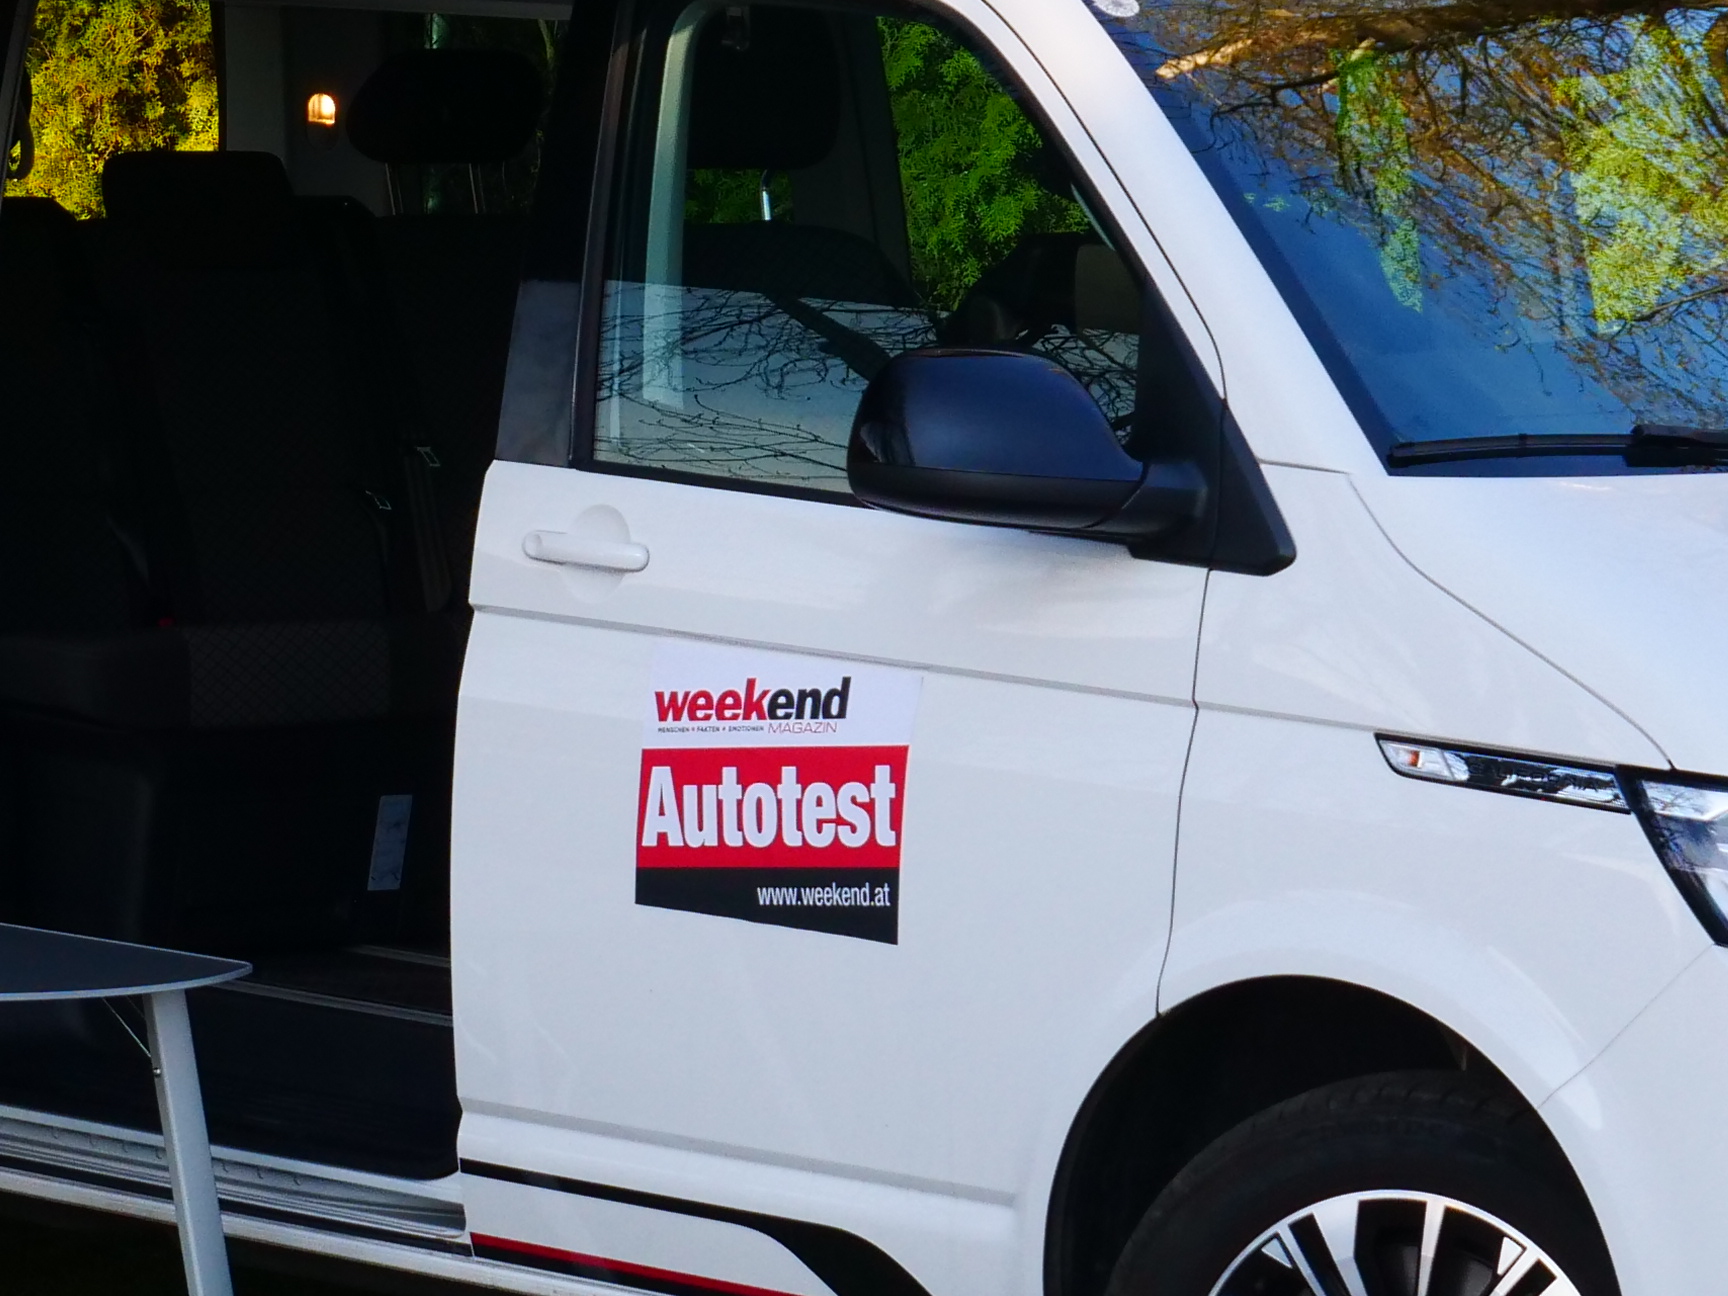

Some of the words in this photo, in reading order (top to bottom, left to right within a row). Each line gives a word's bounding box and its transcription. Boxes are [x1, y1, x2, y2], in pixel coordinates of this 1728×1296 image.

[654, 676, 852, 722] weekend
[767, 722, 838, 734] MAGAZIN
[641, 764, 897, 848] Autotest
[756, 882, 892, 907] www.weekend.at
